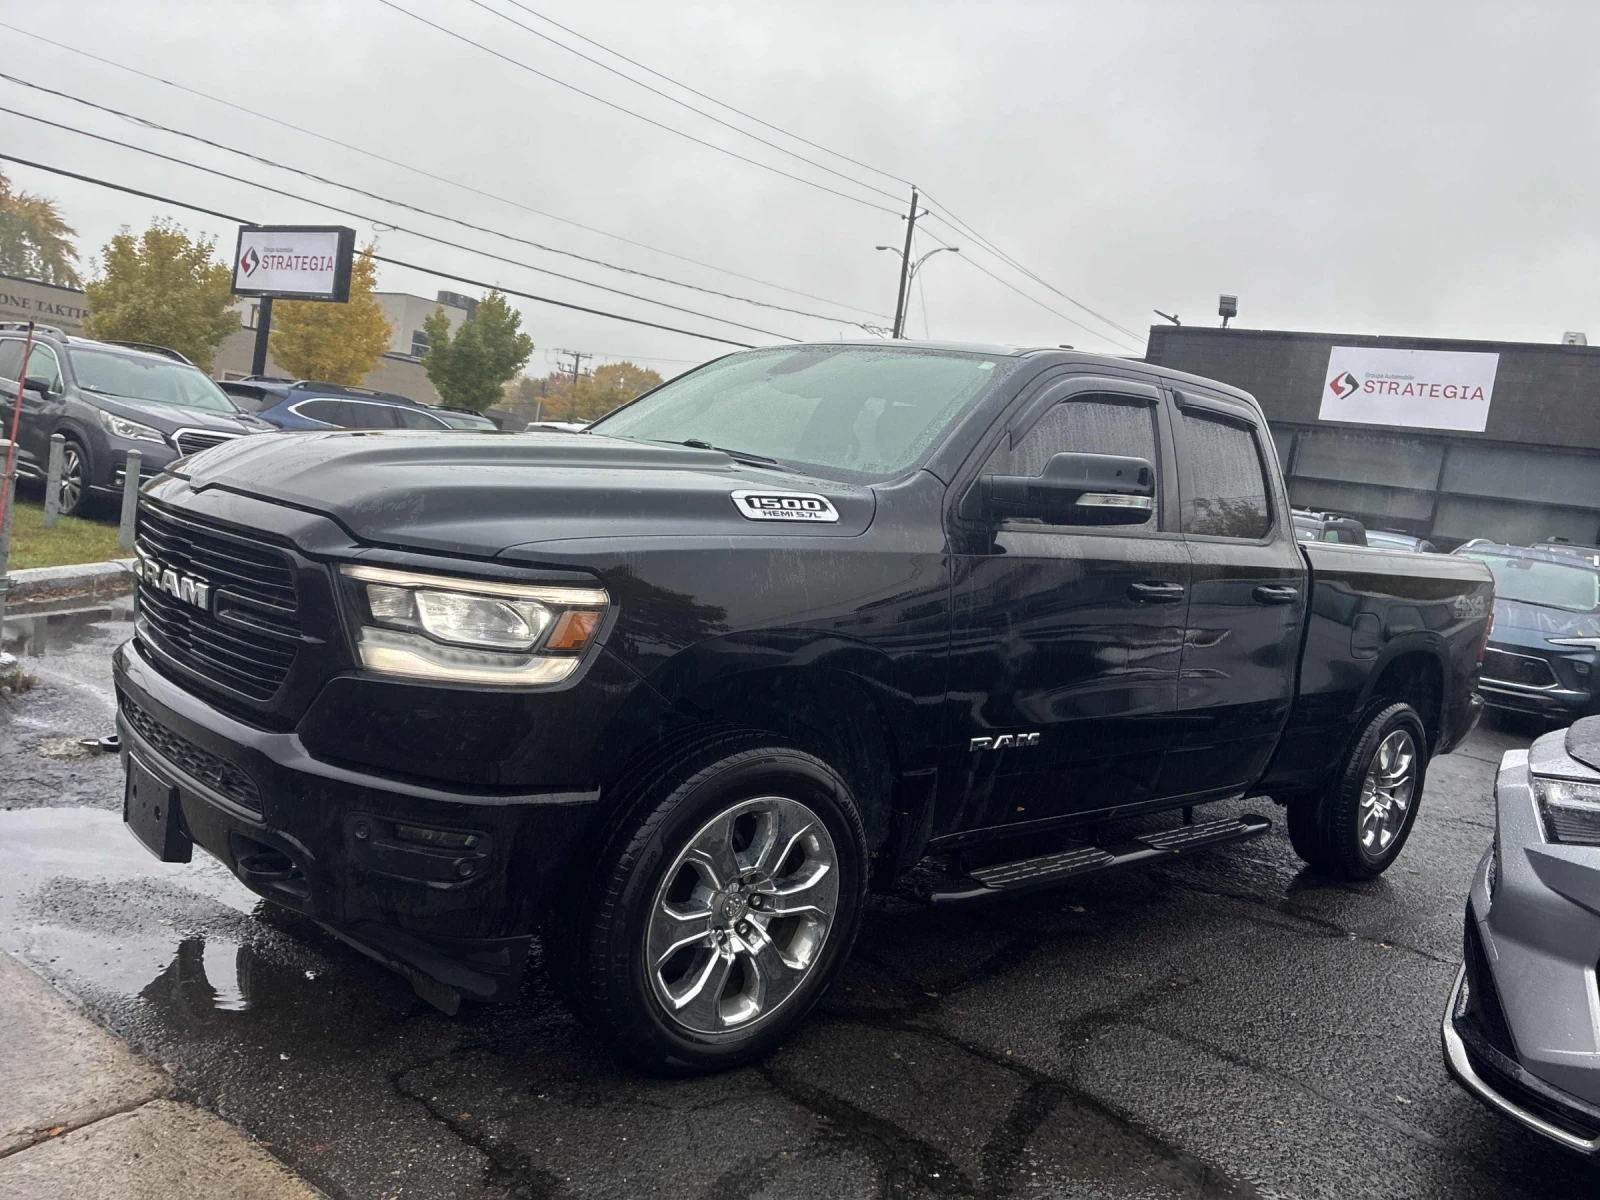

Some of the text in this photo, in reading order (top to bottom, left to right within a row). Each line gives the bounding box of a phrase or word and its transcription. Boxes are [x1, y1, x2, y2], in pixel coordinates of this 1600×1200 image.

[262, 255, 334, 272] STRATEGIA
[1363, 379, 1485, 401] STRATEGIA
[748, 498, 821, 510] 1500
[796, 511, 822, 519] 5.7L
[143, 558, 209, 610] RAM
[969, 732, 1041, 752] RAM
